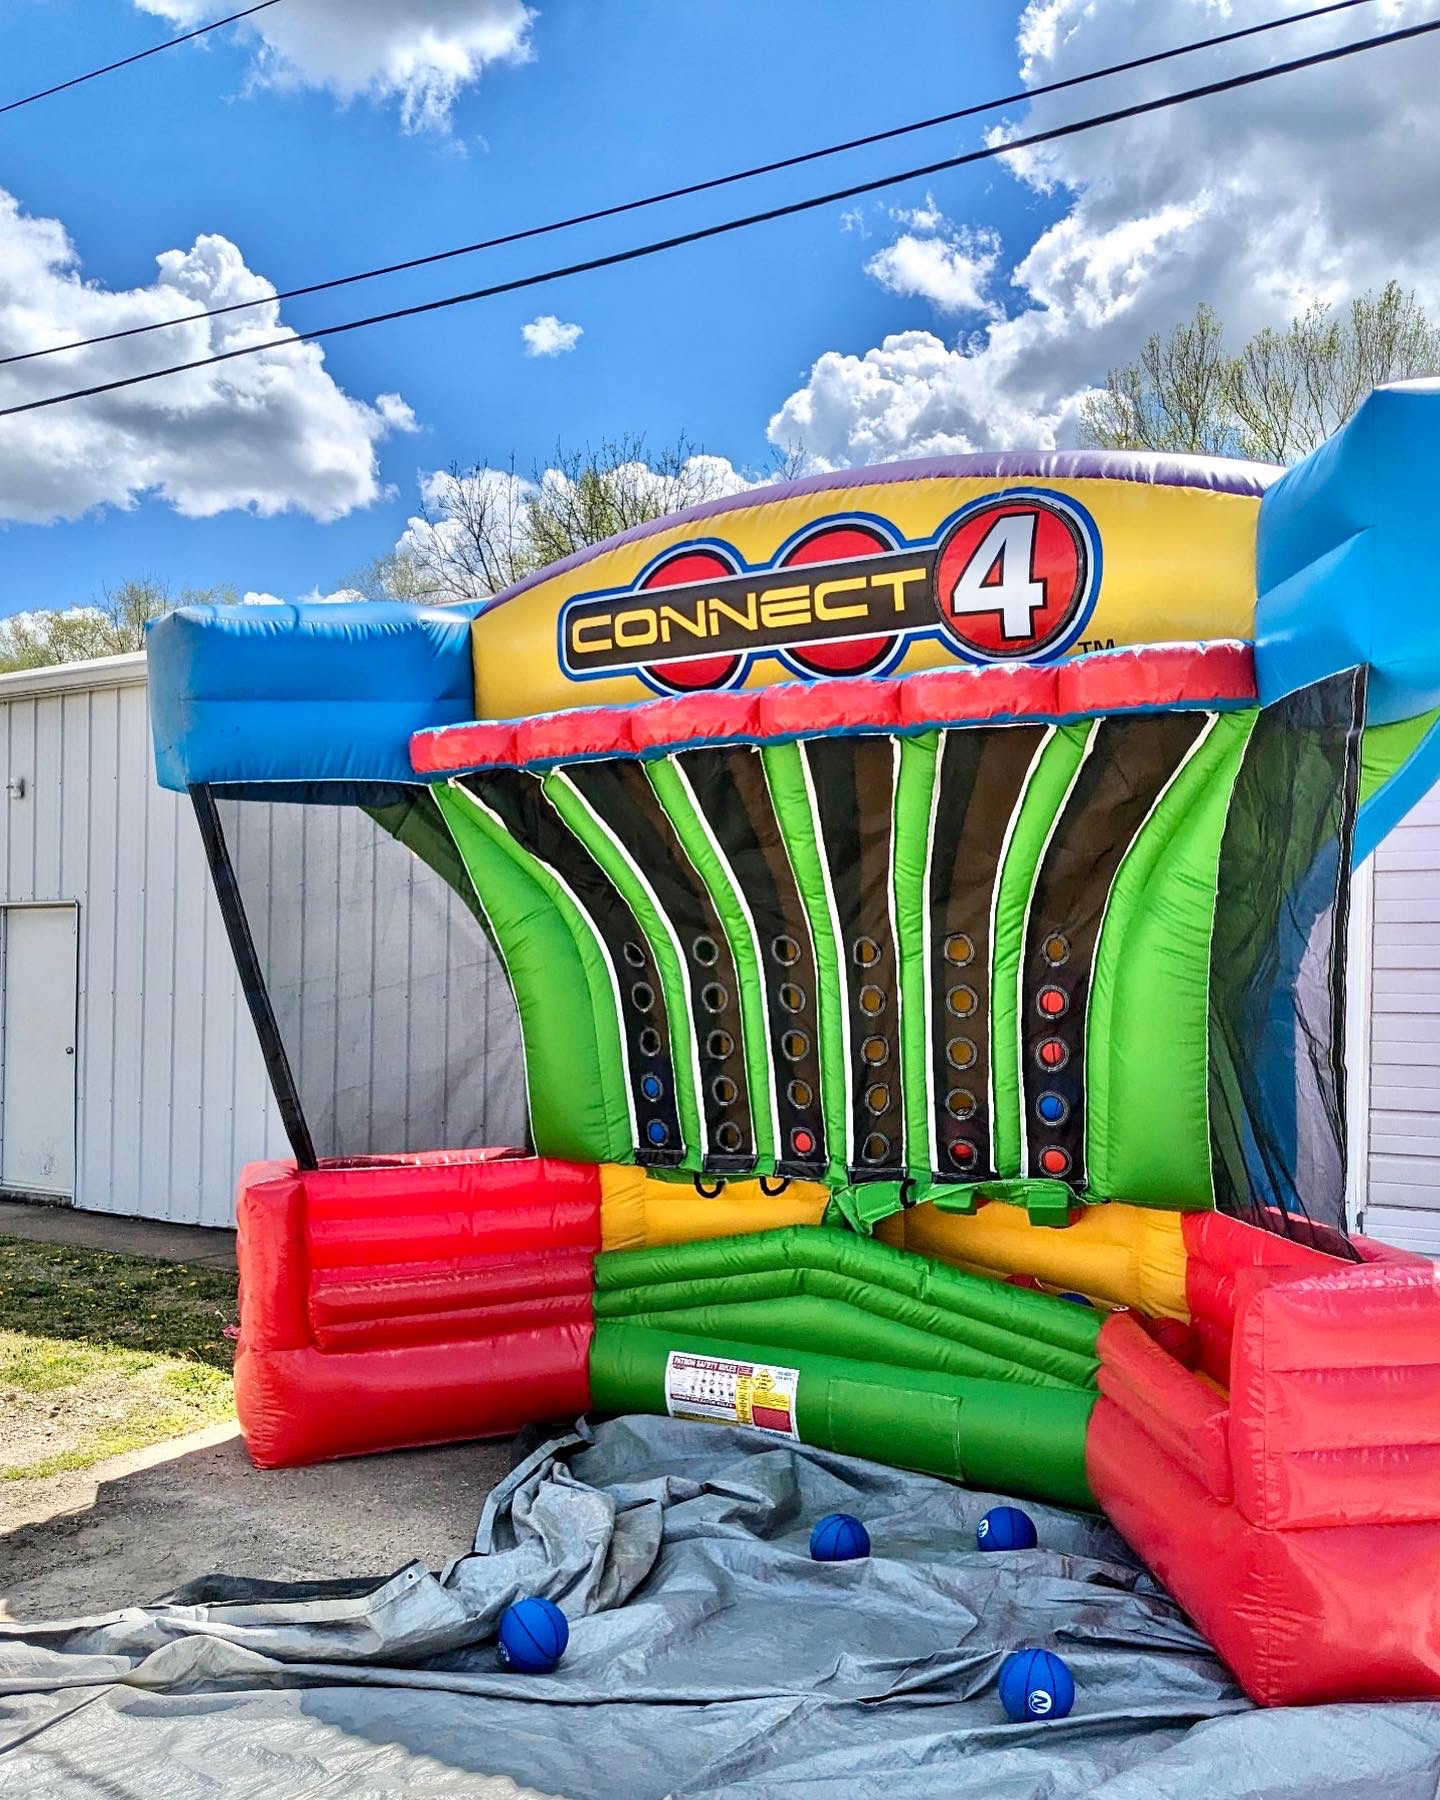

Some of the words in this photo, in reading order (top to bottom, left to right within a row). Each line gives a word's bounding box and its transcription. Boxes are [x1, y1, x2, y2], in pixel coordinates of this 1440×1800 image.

[571, 567, 928, 654] CONNECT
[952, 512, 1048, 641] 4
[1077, 638, 1115, 654] TM
[696, 1359, 717, 1370] SAFETY
[718, 1363, 737, 1373] RULES
